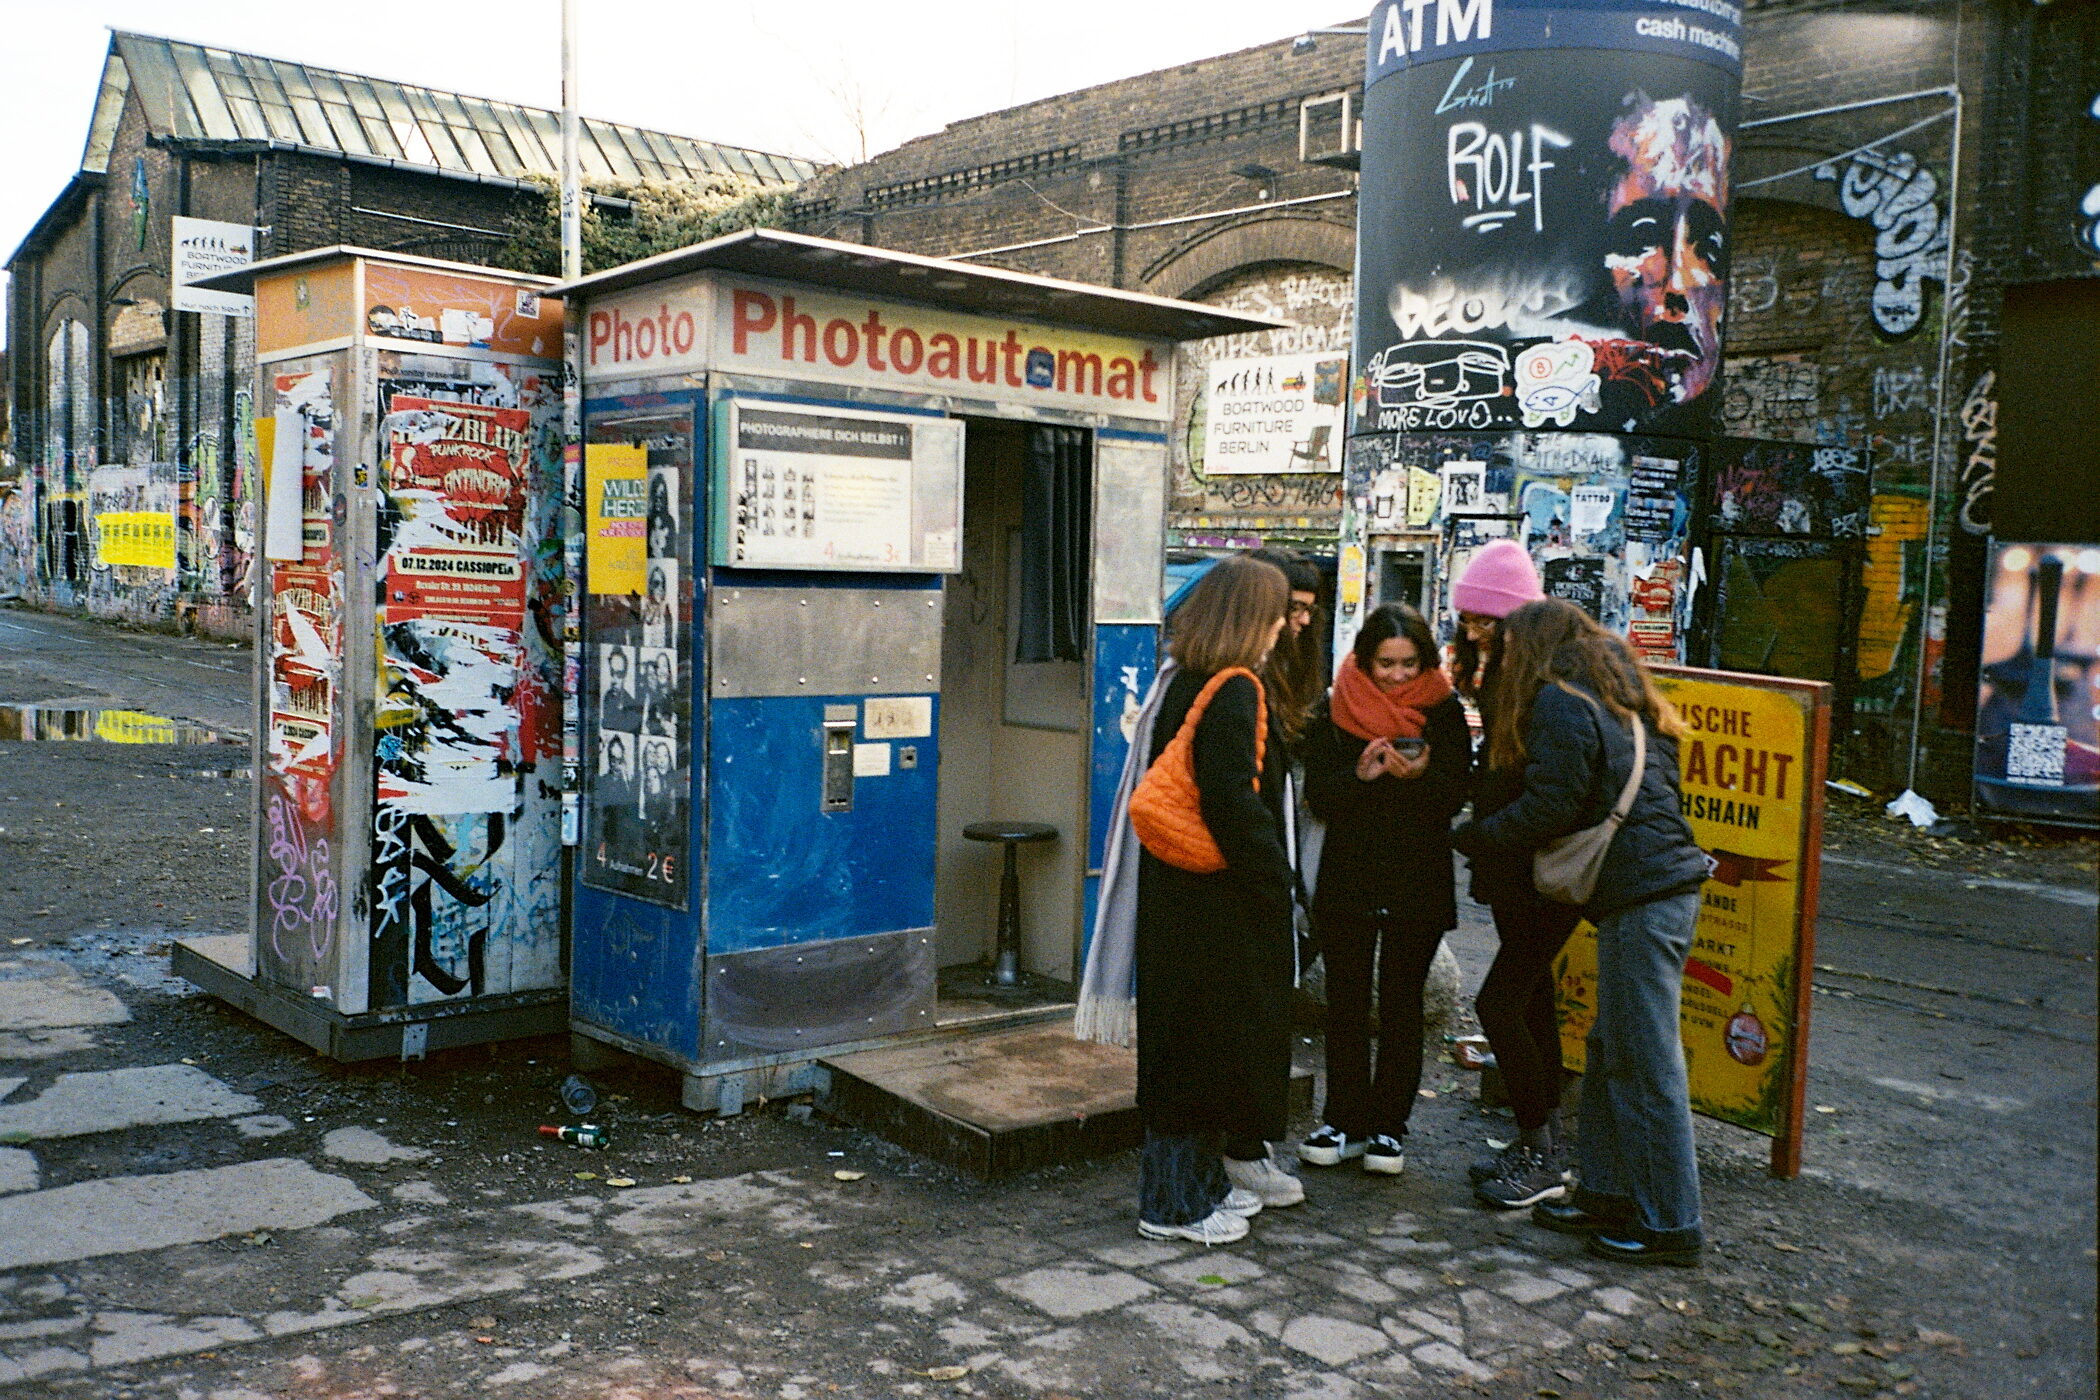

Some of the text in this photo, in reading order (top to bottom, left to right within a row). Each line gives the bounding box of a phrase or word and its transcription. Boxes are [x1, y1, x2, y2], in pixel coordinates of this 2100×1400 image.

[1378, 0, 1492, 66] ATM
[1635, 16, 1686, 41] cash
[1447, 121, 1574, 232] ROLF
[187, 251, 248, 265] BOATWOOD
[589, 304, 696, 367] Photo
[1223, 399, 1305, 416] BOATWOOD
[860, 430, 898, 446] SELBST
[1214, 419, 1293, 436] FURNITURE
[1219, 440, 1270, 455] BERLIN
[1575, 494, 1610, 503] TATTOO
[402, 557, 454, 571] 07.12.2024
[1681, 702, 1753, 738] ISCHE
[1684, 740, 1794, 800] ACHT
[1680, 792, 1761, 830] HSHAIN
[596, 842, 607, 868] 4
[1704, 887, 1738, 912] ÄNDE
[1696, 938, 1736, 957] ARKT
